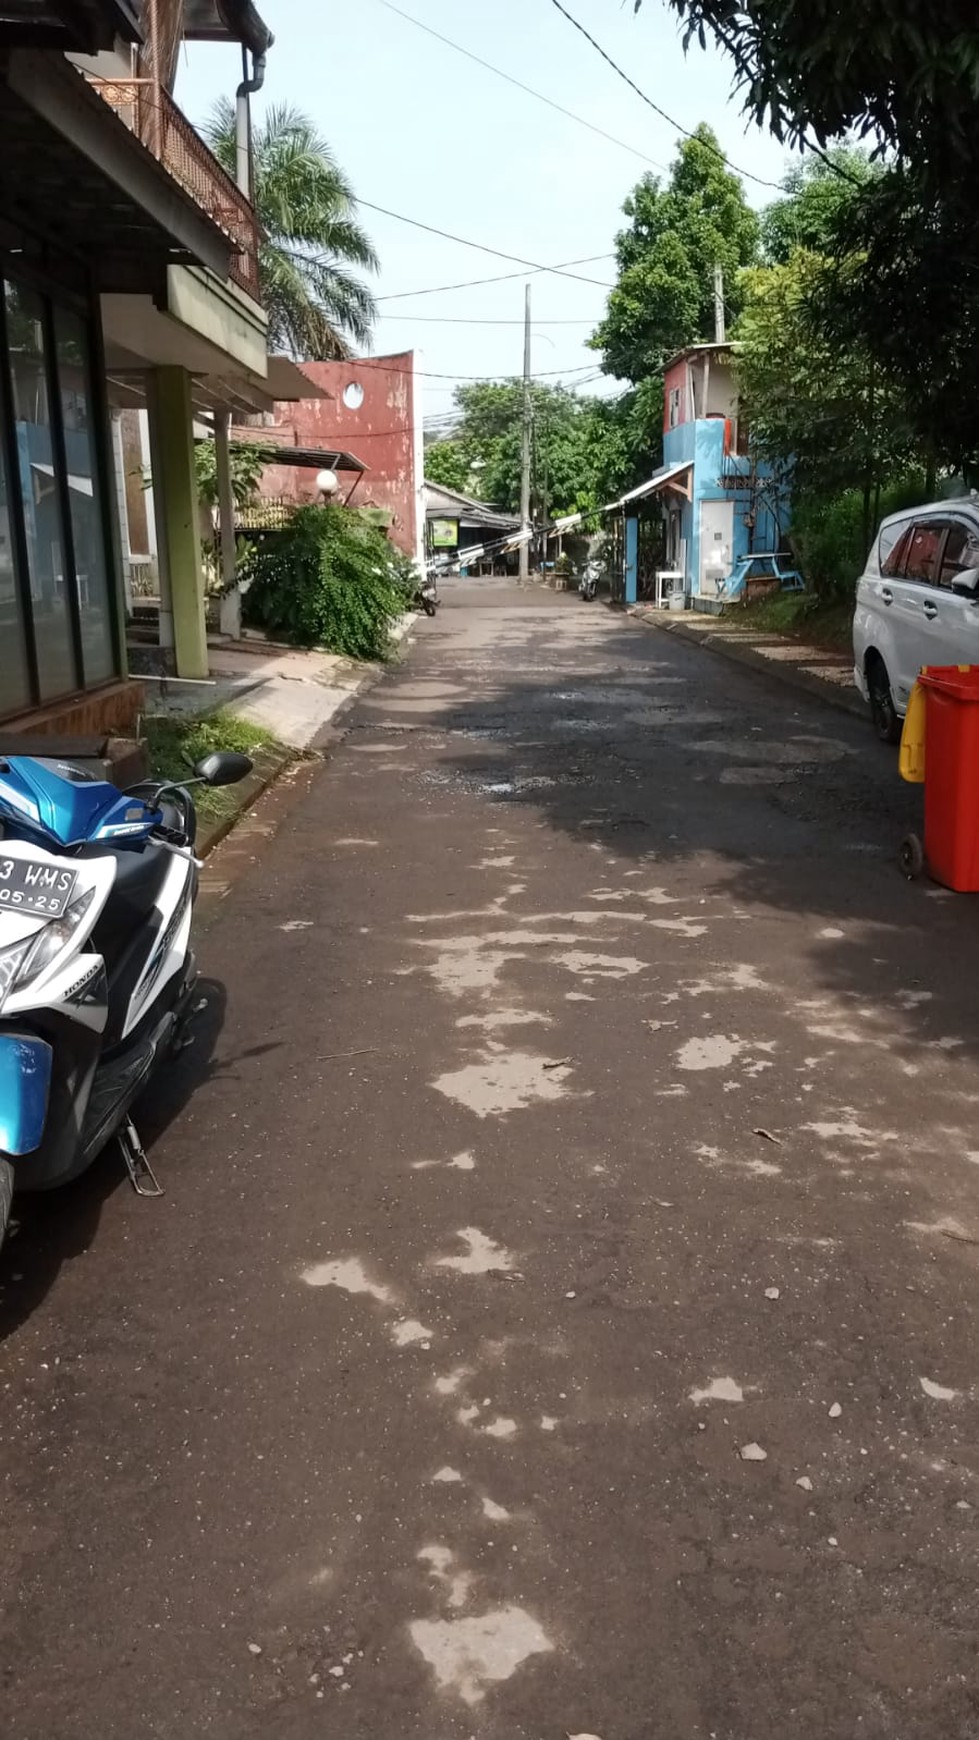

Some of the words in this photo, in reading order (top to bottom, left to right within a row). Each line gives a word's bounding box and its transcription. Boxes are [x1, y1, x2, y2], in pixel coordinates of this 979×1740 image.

[0, 861, 14, 879] 3
[25, 865, 71, 891] WMS
[63, 964, 99, 997] HONDA
